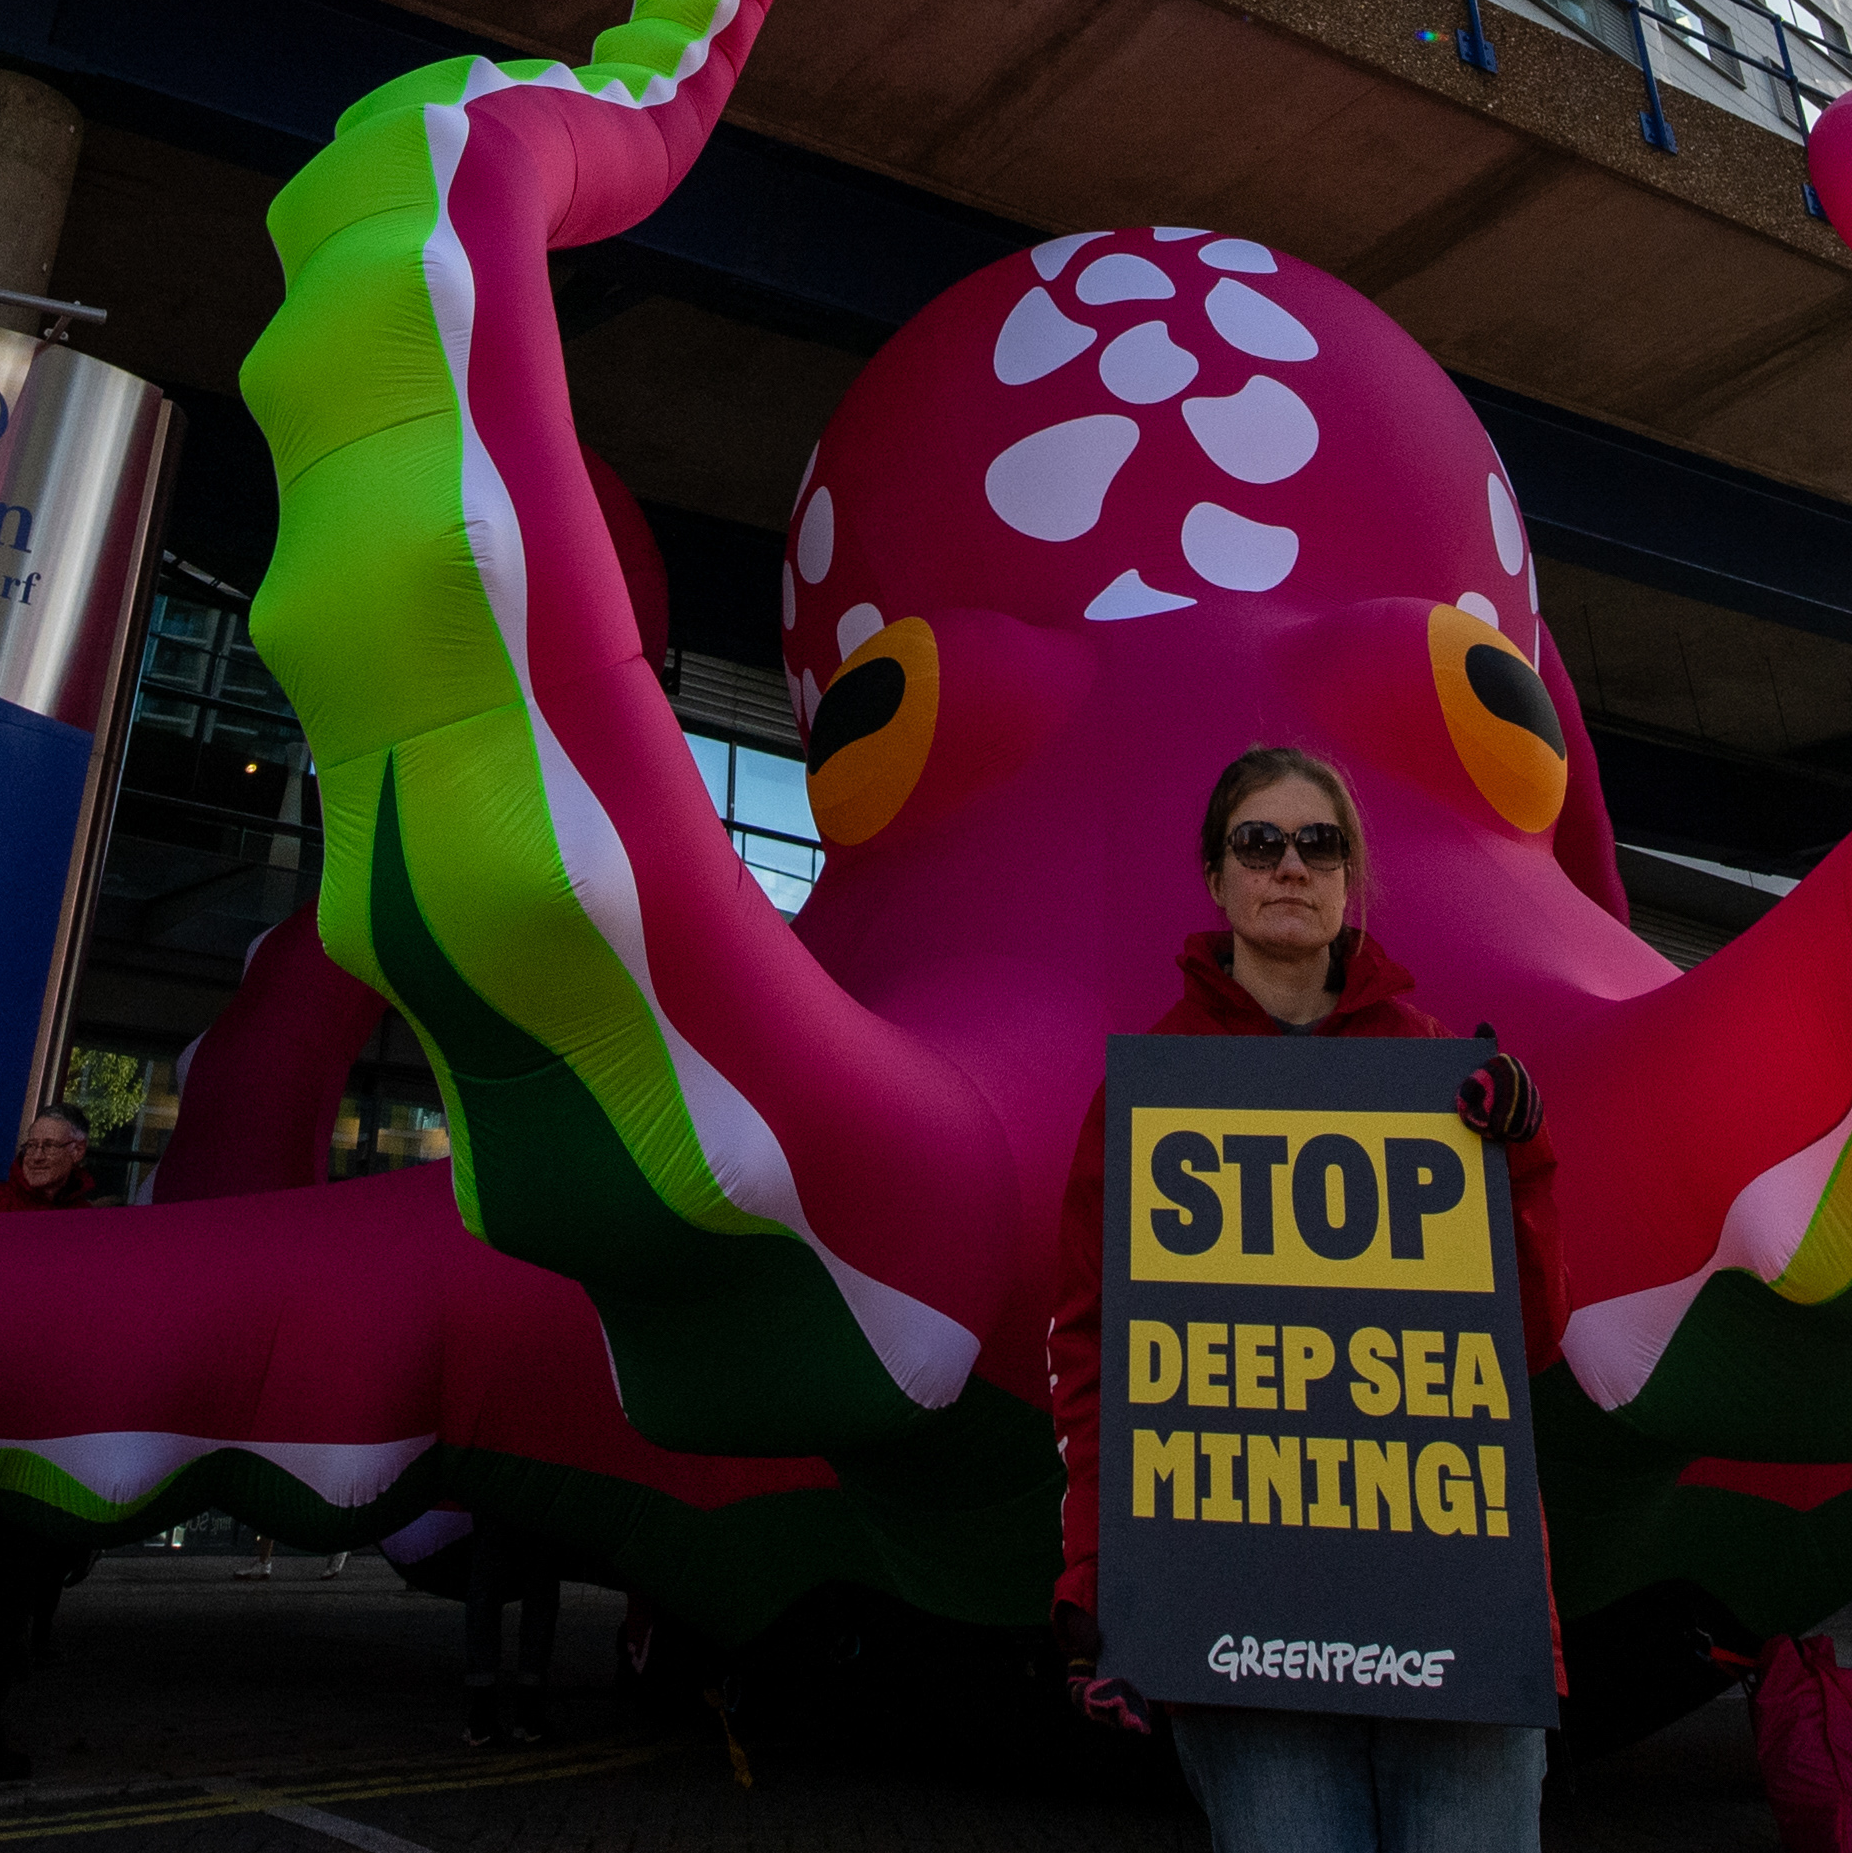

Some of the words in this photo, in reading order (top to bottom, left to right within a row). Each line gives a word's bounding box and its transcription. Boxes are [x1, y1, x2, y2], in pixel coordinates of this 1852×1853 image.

[1149, 1129, 1467, 1261] STOP
[1128, 1319, 1336, 1412] DEEP
[1347, 1326, 1511, 1421] SEA
[1131, 1428, 1511, 1538] MINING!
[1207, 1633, 1456, 1688] GREENPEACE
